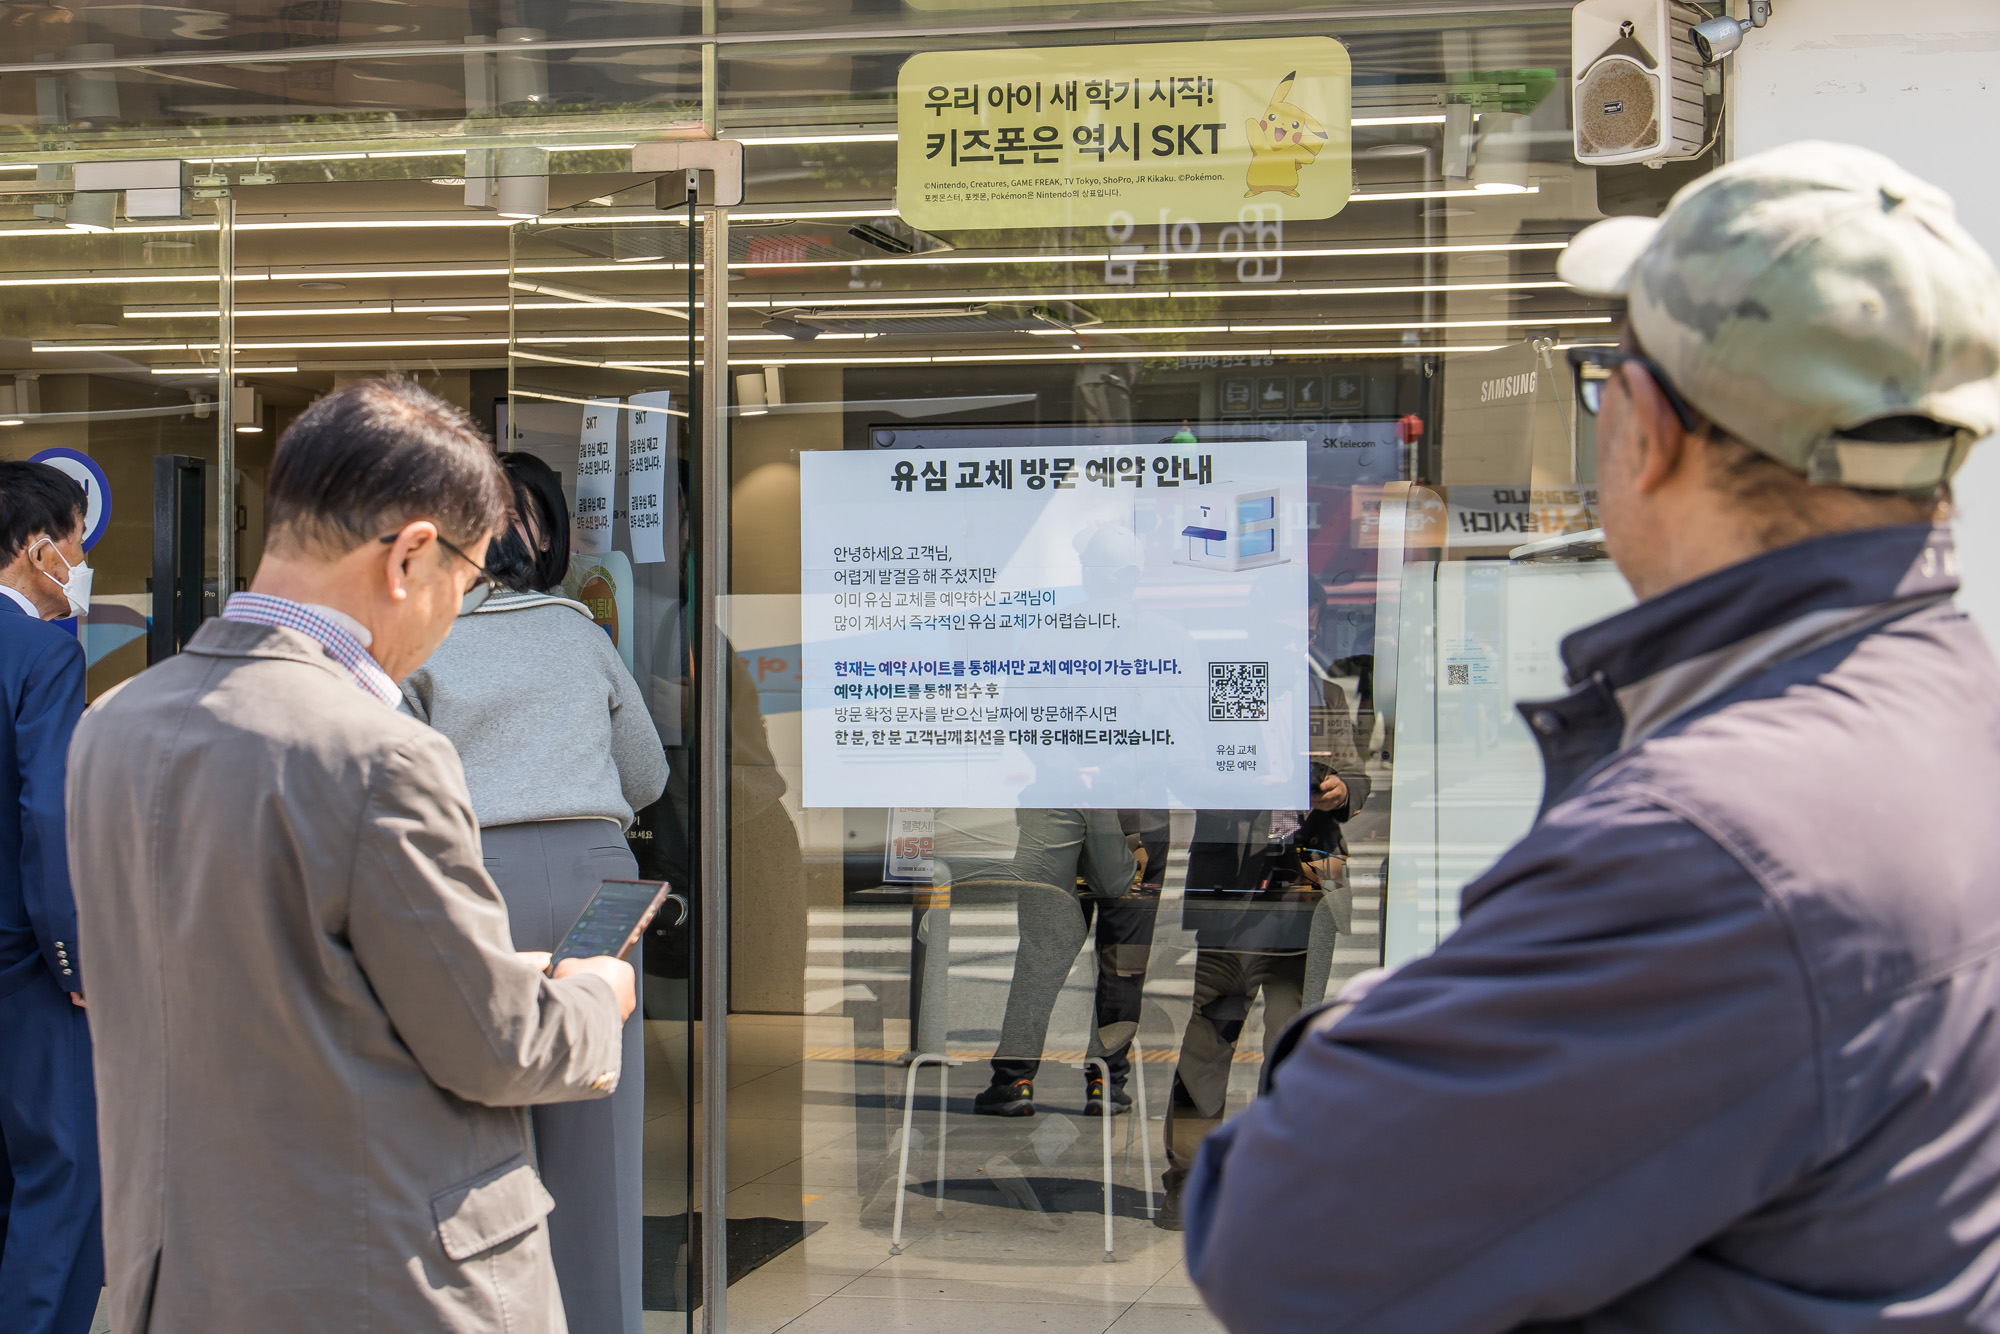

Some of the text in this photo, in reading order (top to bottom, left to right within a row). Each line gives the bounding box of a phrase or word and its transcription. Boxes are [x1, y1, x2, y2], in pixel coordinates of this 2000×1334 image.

[925, 76, 1213, 116] 우리 아이 새 학기 시작!
[926, 123, 1226, 167] 키즈폰은 역시 SKT
[970, 180, 1009, 189] Creatures,
[1011, 179, 1032, 187] GAME
[1035, 178, 1062, 187] FREAK,
[1076, 177, 1101, 186] Tokyo,
[1103, 176, 1134, 185] ShoPro,
[1147, 174, 1176, 183] Kikaku.
[924, 189, 1121, 203] 포켓몬스터, 포켓몬, Pokémon은 Nintendo의 상표입니다.
[1481, 371, 1536, 402] SAMSUNG
[586, 416, 597, 429] SKT
[635, 411, 647, 424] SKT
[587, 442, 596, 457] 유심
[597, 441, 608, 455] 재고
[637, 438, 646, 453] 유심
[647, 437, 658, 451] 재고
[1323, 438, 1376, 448] SK telecom
[891, 455, 1212, 492] 유심 교체 방문 예약 안내
[588, 498, 596, 511] 유심
[597, 497, 606, 511] 재고
[639, 494, 647, 509] 유심
[648, 494, 656, 508] 재고
[834, 545, 952, 562] 안녕하세요 고객님,
[834, 569, 876, 585] 어렵게
[879, 569, 920, 584] 발걸음
[940, 568, 997, 584] 주셨지만
[834, 590, 1056, 608] 이미 유심 교체를 예약하신 고객님이
[834, 613, 1121, 631] 많이 계셔서 즉각적인 유심 교체가 어렵습니다.
[834, 659, 1182, 676] 현재는 예약 사이트를 통해서만 교체 예약이 가능합니다.
[834, 683, 1000, 699] 예약 사이트를 통해 접수 후
[834, 706, 1118, 722] 방문 확정 문자를 받으신 날짜에 방문해주시면
[835, 729, 1175, 747] 한 분, 한 분 고객님께 최선을 다해 응대해드리겠습니다.
[1216, 745, 1257, 755] 유심 교체
[1216, 760, 1257, 772] 방문 예약
[902, 821, 933, 832] 갤럭시
